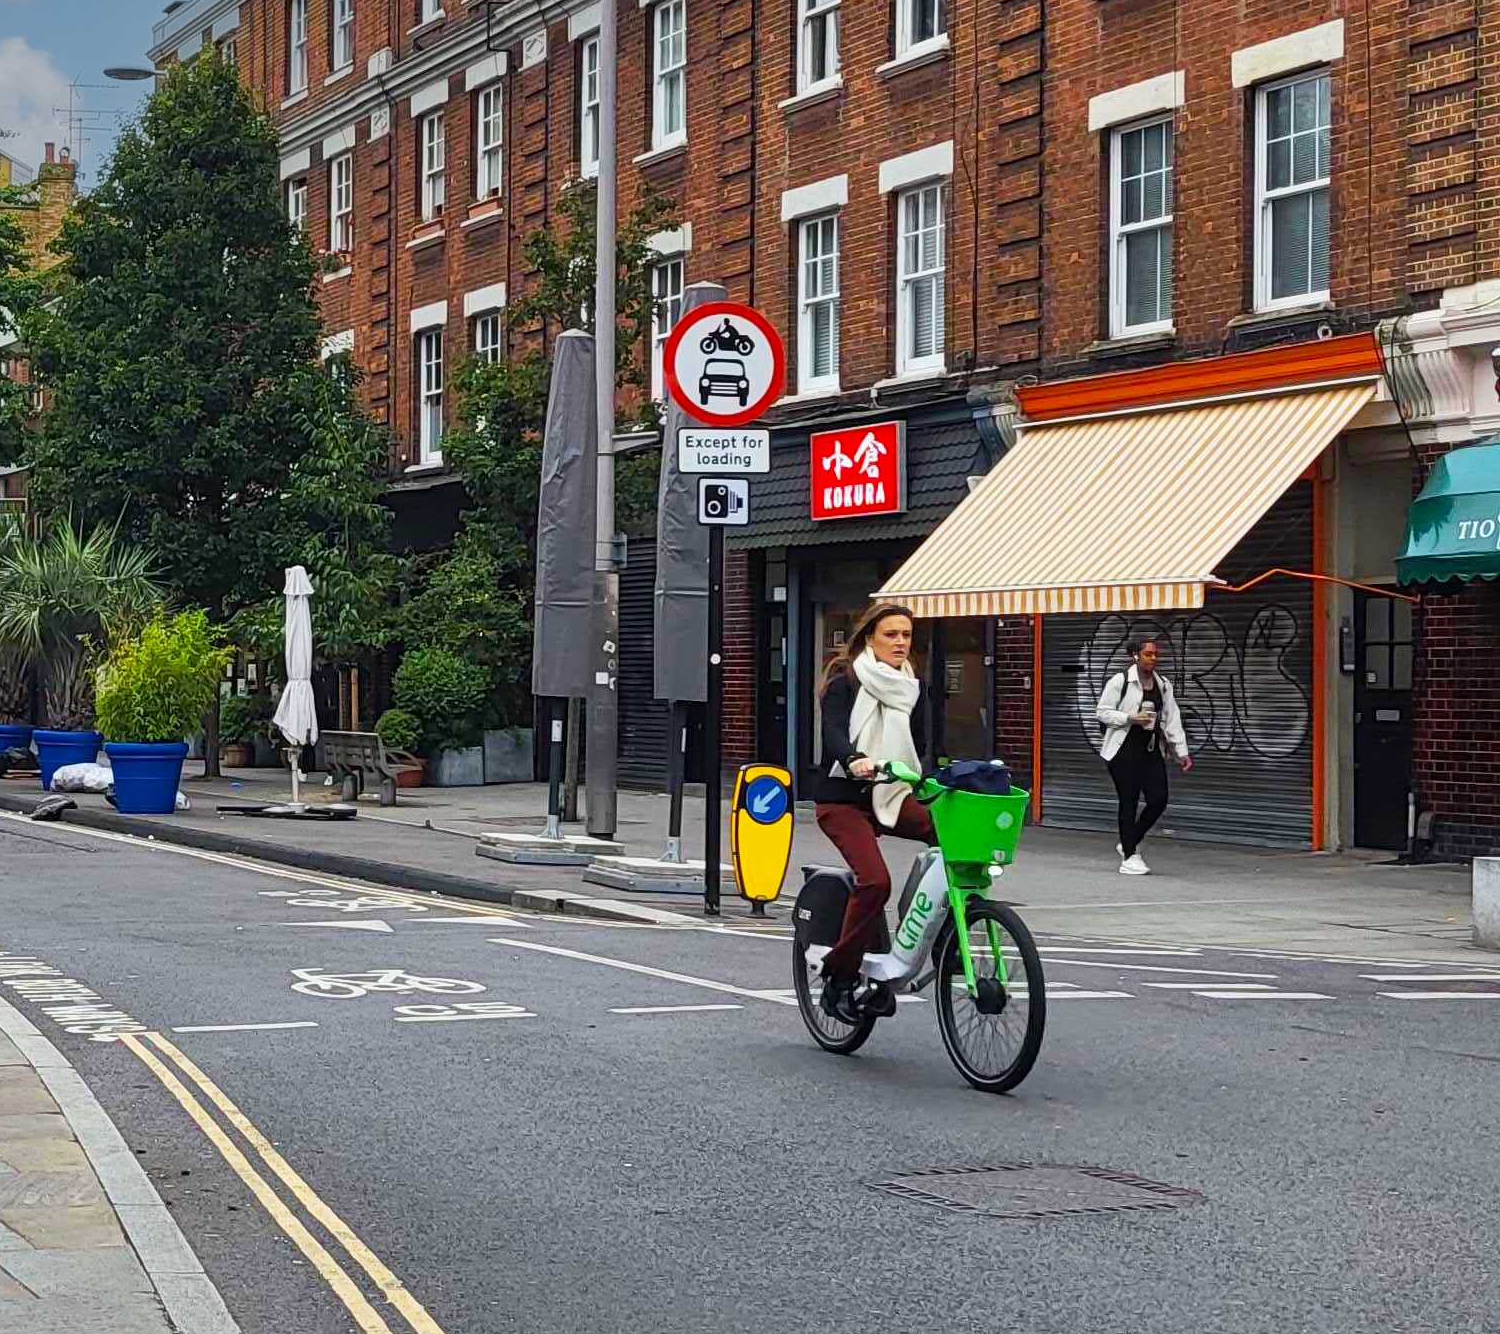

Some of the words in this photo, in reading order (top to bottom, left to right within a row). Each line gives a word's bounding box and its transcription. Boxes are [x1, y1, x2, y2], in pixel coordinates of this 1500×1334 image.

[685, 435, 737, 450] Except
[742, 435, 764, 448] for
[697, 452, 752, 468] loading
[823, 481, 886, 510] KOKURA
[895, 890, 934, 951] Lime
